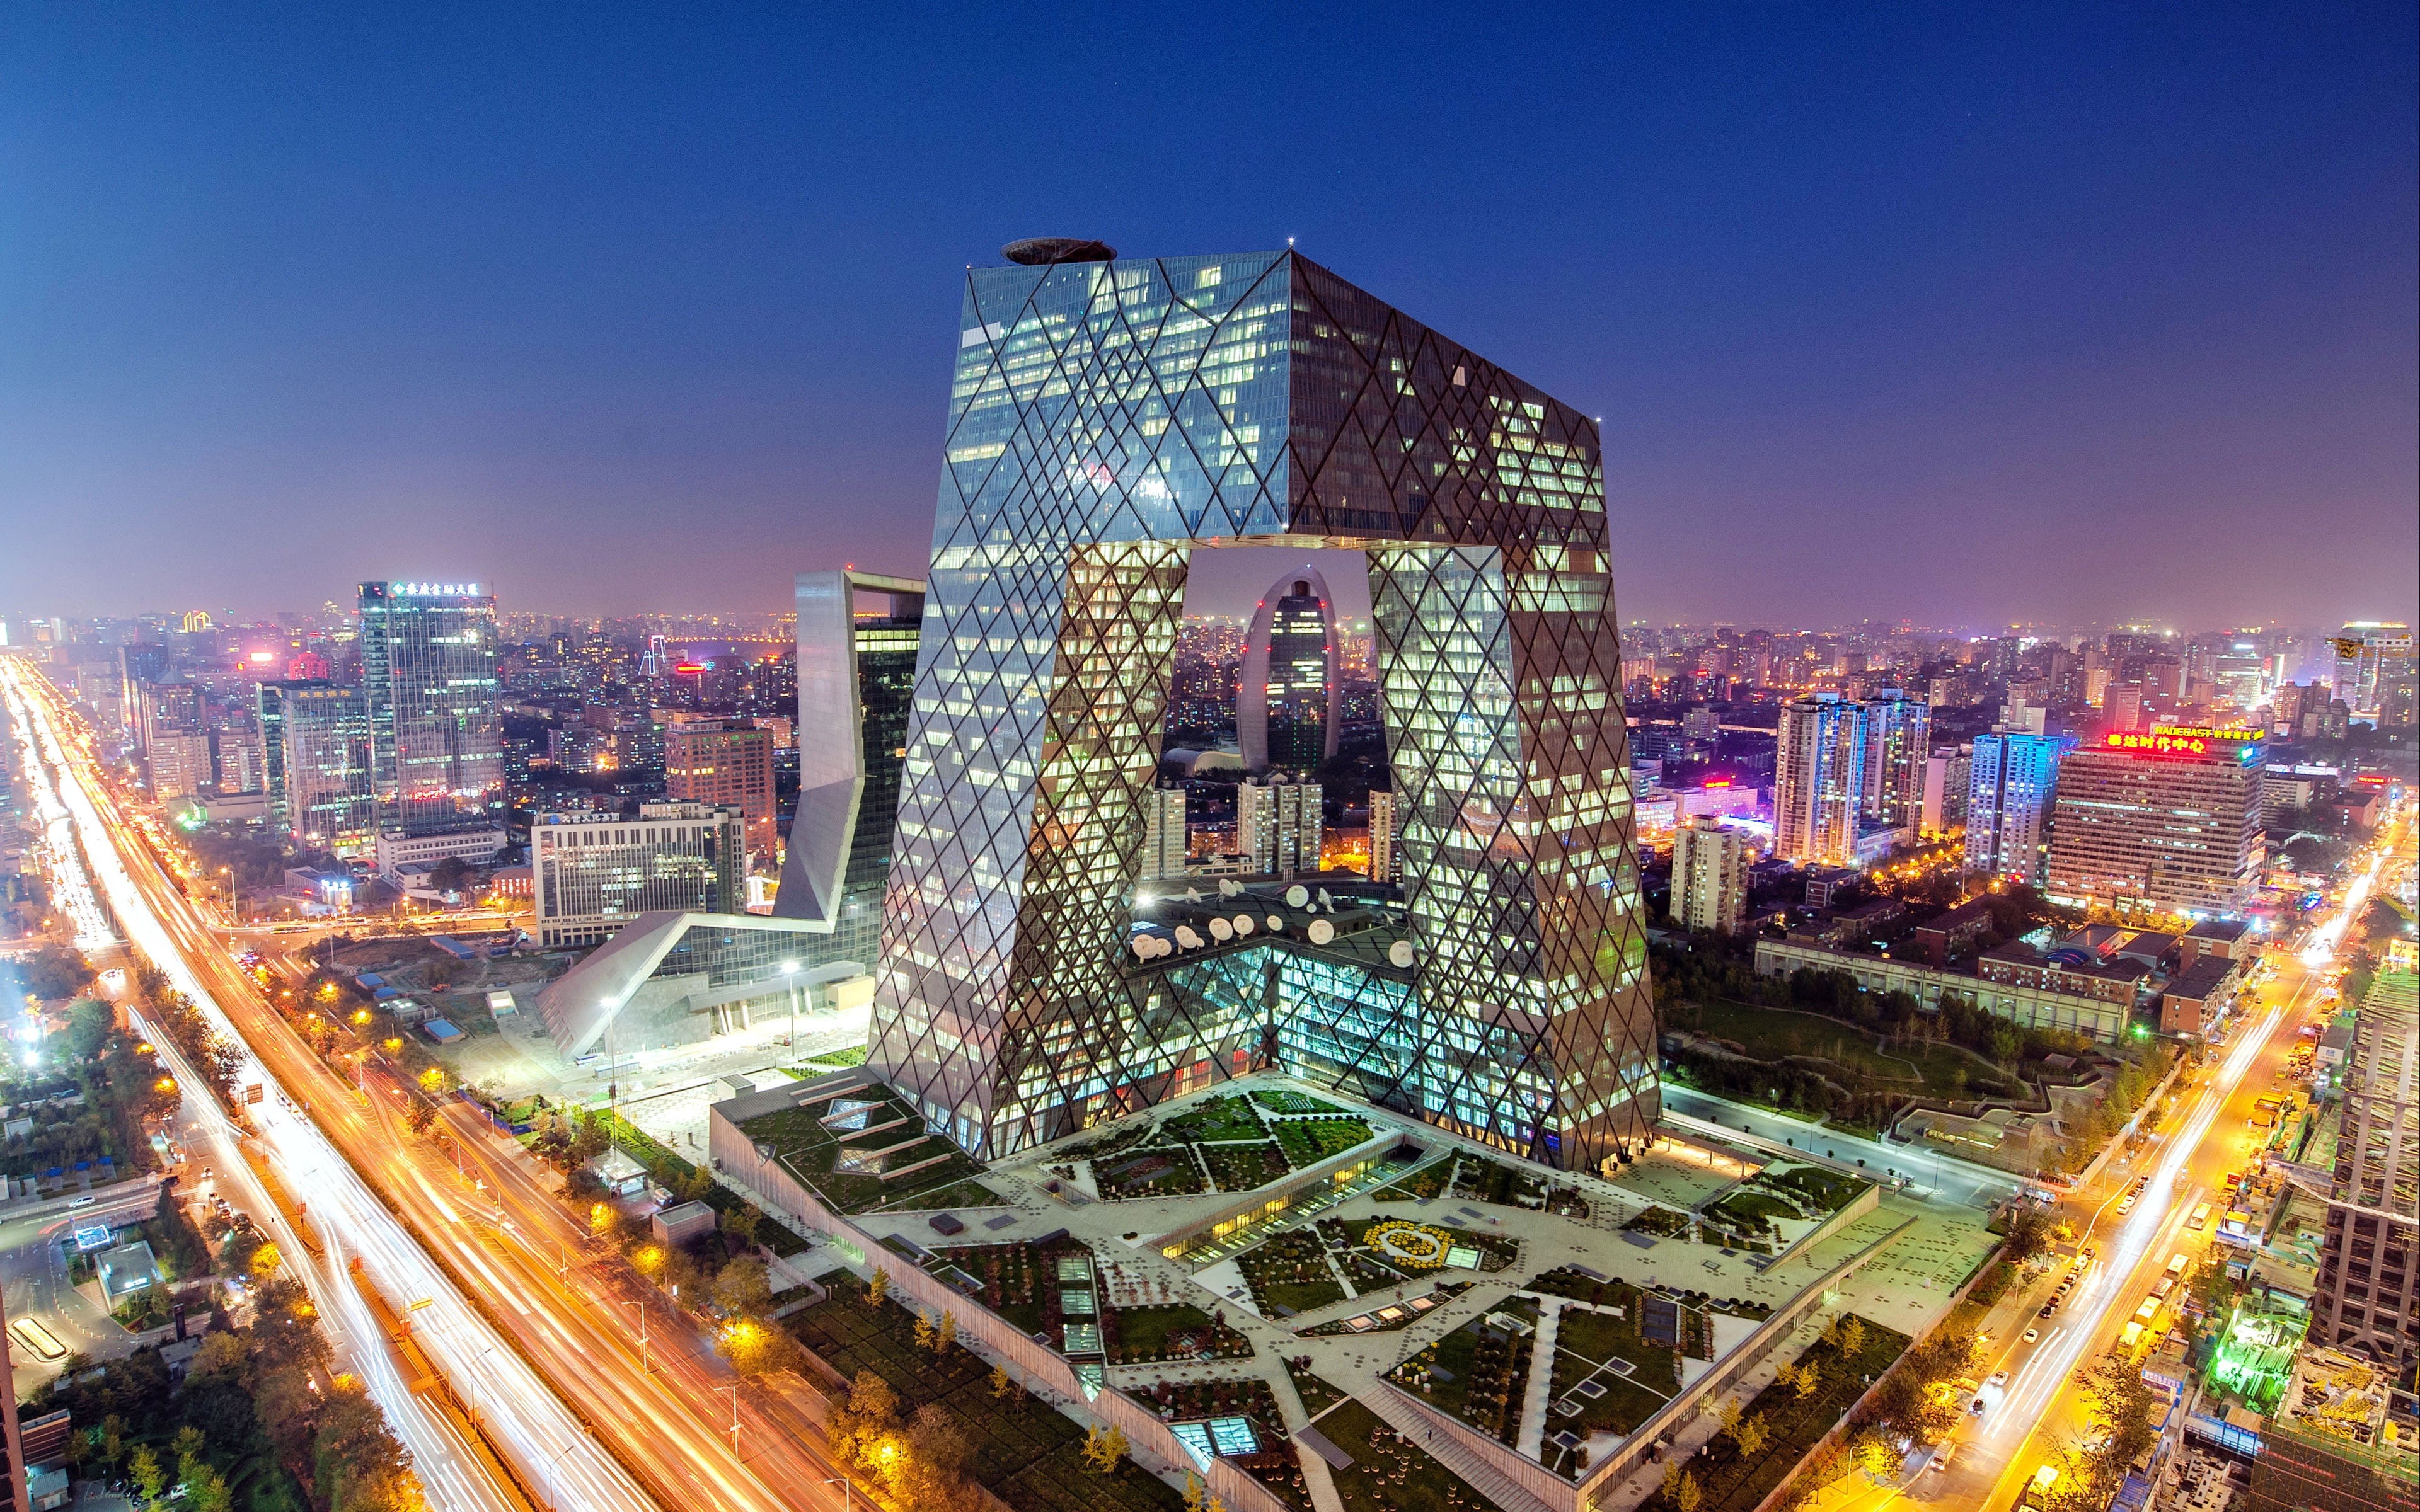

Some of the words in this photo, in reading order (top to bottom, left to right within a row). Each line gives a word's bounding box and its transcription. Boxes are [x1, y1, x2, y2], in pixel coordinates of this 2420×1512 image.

[2155, 726, 2211, 738] RADEGAST
[2107, 734, 2205, 753] 泰达时代中心
